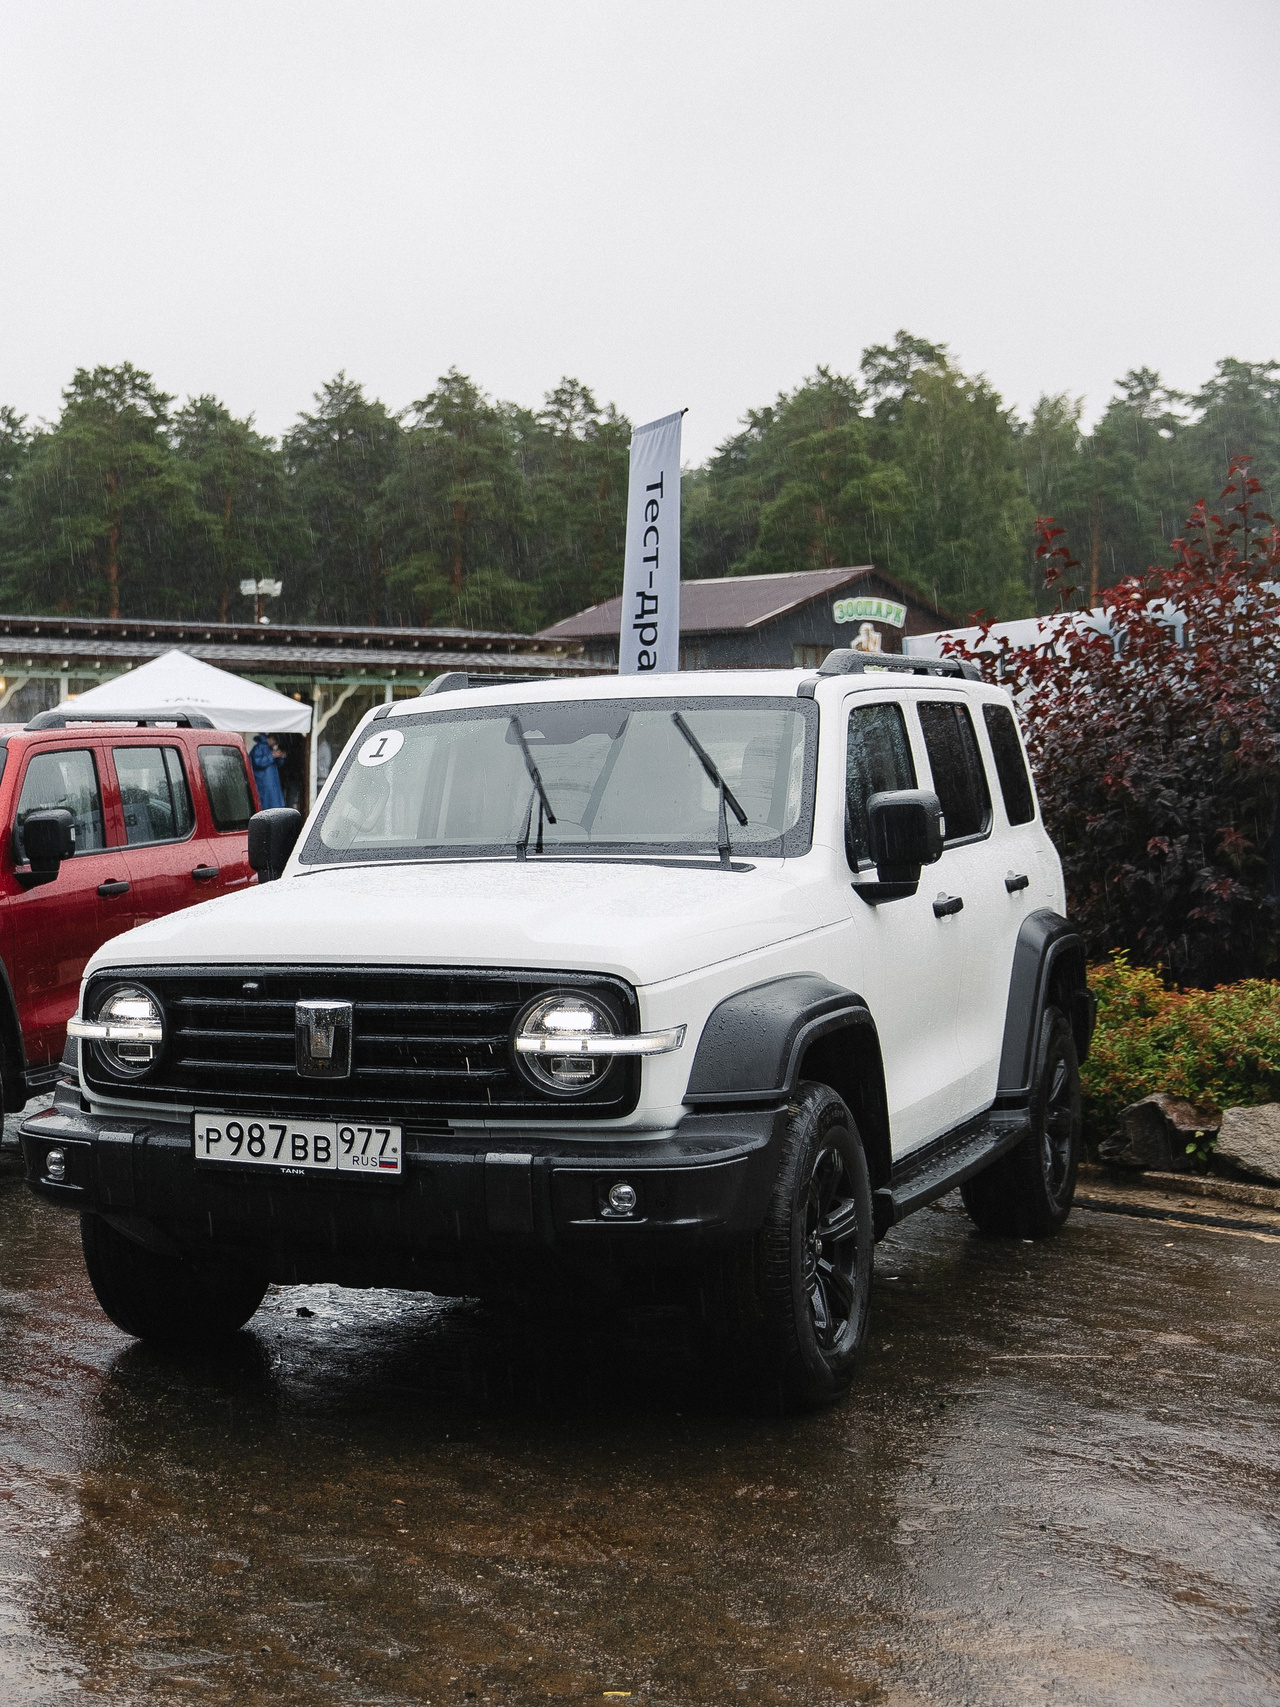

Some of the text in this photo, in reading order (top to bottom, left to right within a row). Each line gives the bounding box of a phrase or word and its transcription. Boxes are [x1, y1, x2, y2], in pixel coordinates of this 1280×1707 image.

[632, 470, 664, 672] Тест-дра
[836, 600, 903, 623] ЗООПАРК
[368, 737, 389, 759] 1
[205, 1121, 391, 1163] Р987ВВ 977
[280, 1167, 305, 1176] TANK
[352, 1156, 378, 1167] RUS
